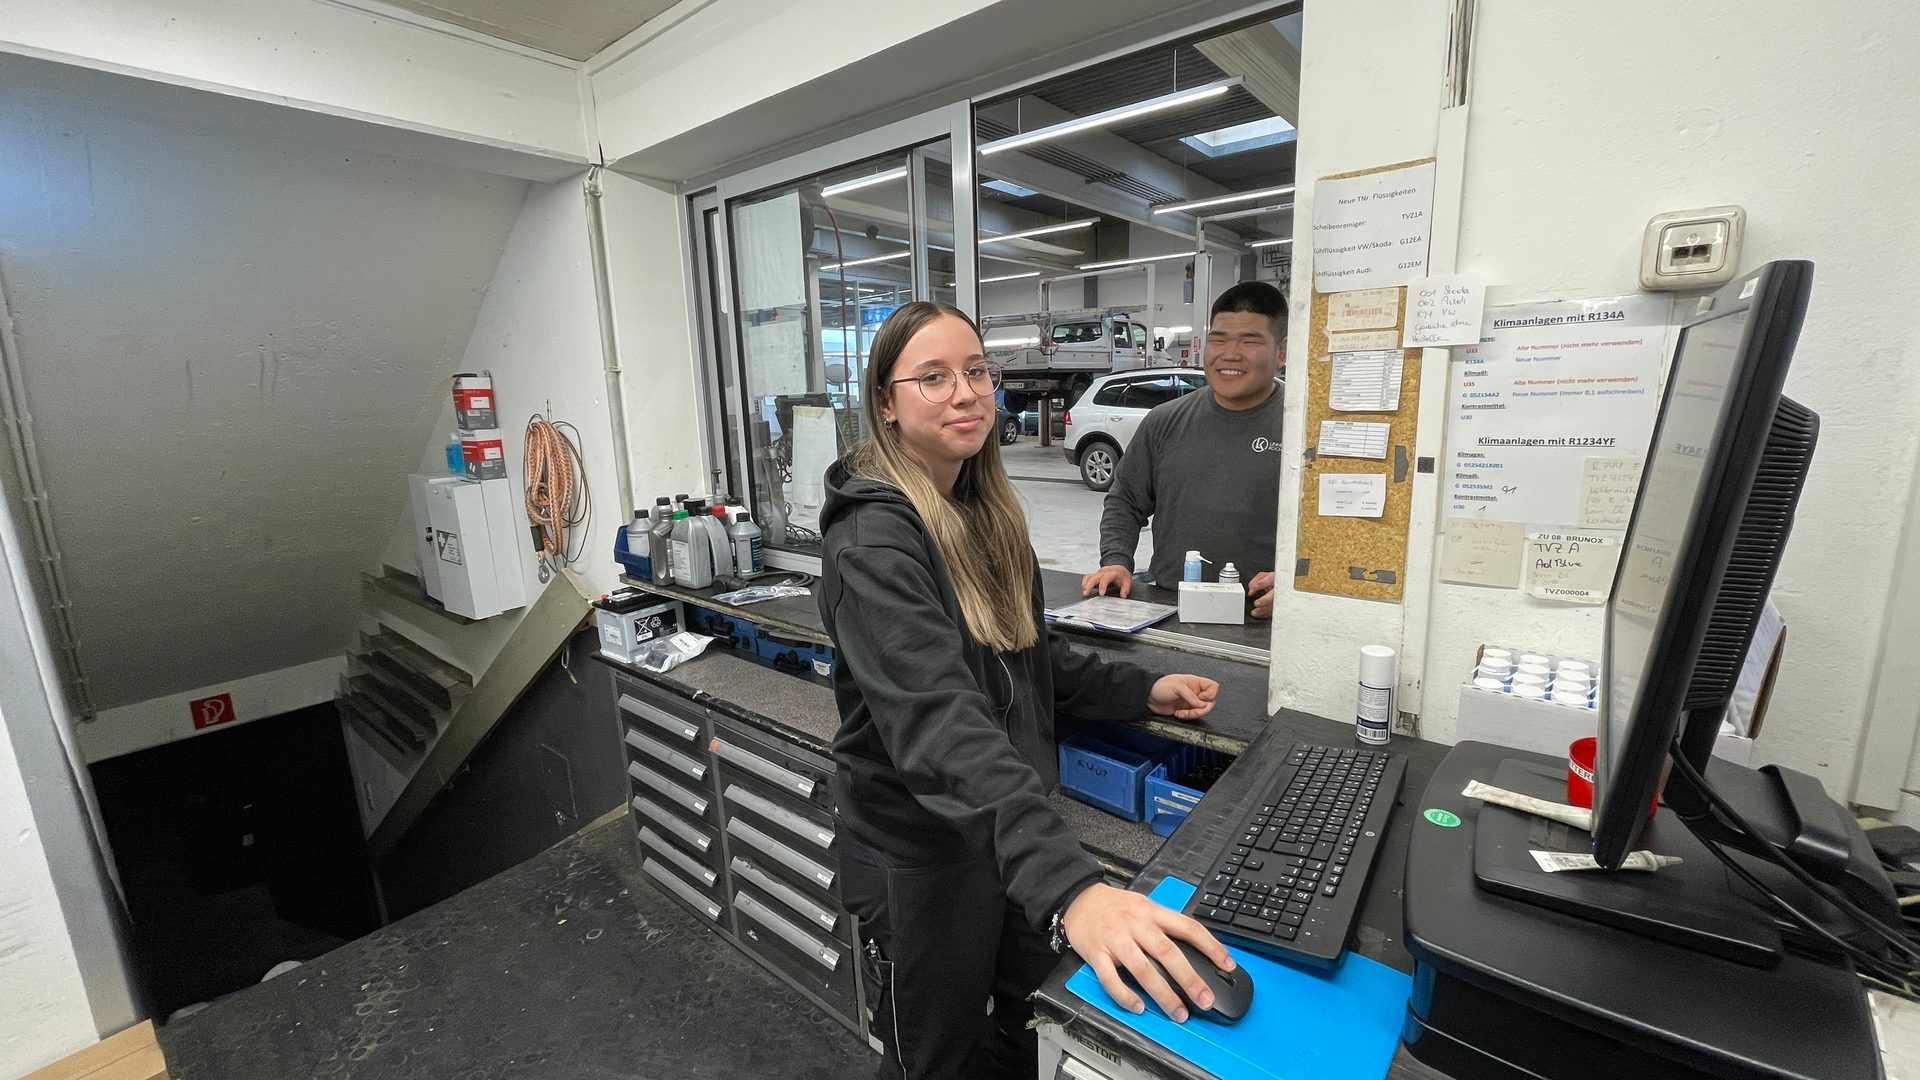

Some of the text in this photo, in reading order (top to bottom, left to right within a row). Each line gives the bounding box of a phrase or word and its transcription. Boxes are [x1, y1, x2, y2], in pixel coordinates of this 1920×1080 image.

[1372, 187, 1417, 200] Flüssigkeiten
[1402, 210, 1423, 219] TVZ1A
[1313, 220, 1367, 231] Scheibenreiniger:
[1399, 235, 1422, 245] G12EA
[1398, 260, 1422, 270] G12EM
[1493, 310, 1625, 328] Klimaanlagen mit R134A
[1478, 437, 1616, 446] Klimaanlagen mit R1234YF
[1566, 535, 1604, 544] BRUNOX
[1568, 542, 1580, 554] A
[1544, 588, 1590, 597] TVZ000004
